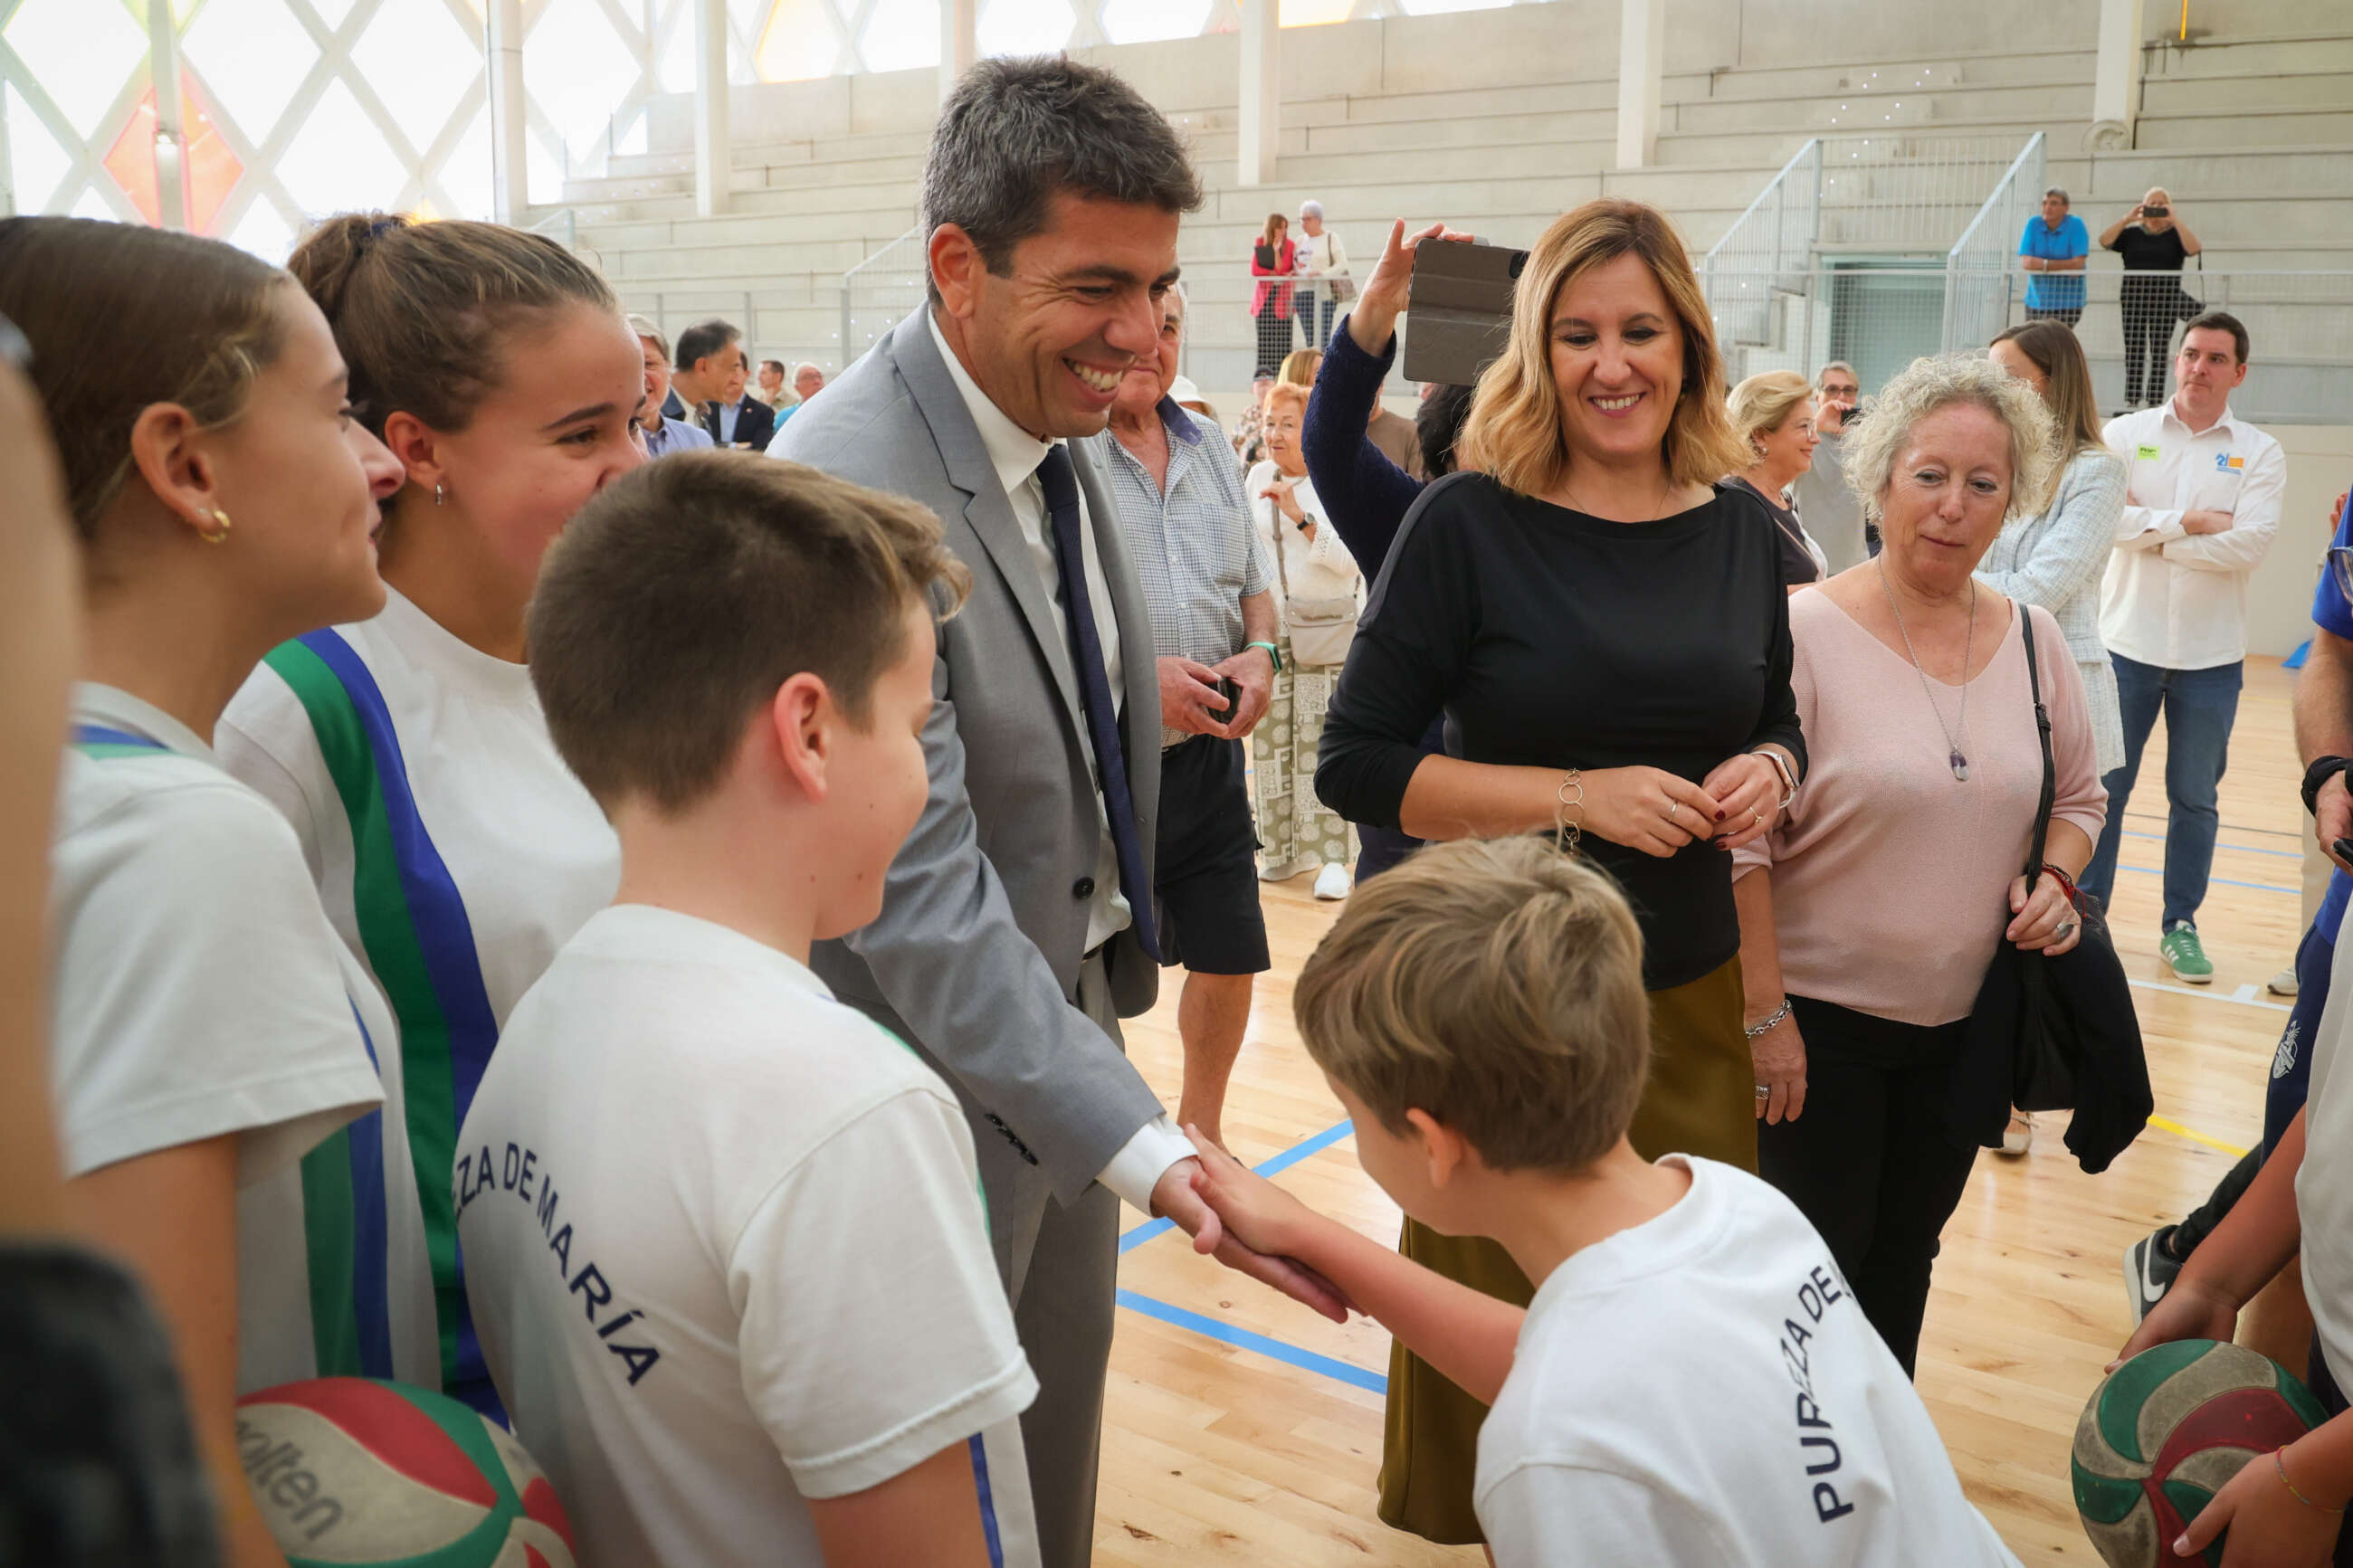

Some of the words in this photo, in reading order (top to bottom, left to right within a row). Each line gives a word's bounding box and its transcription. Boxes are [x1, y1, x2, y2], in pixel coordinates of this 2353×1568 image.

[502, 1141, 537, 1204] DE
[537, 1173, 661, 1387] MARÍA
[1797, 1265, 1843, 1324] DE
[236, 1420, 344, 1541] olten
